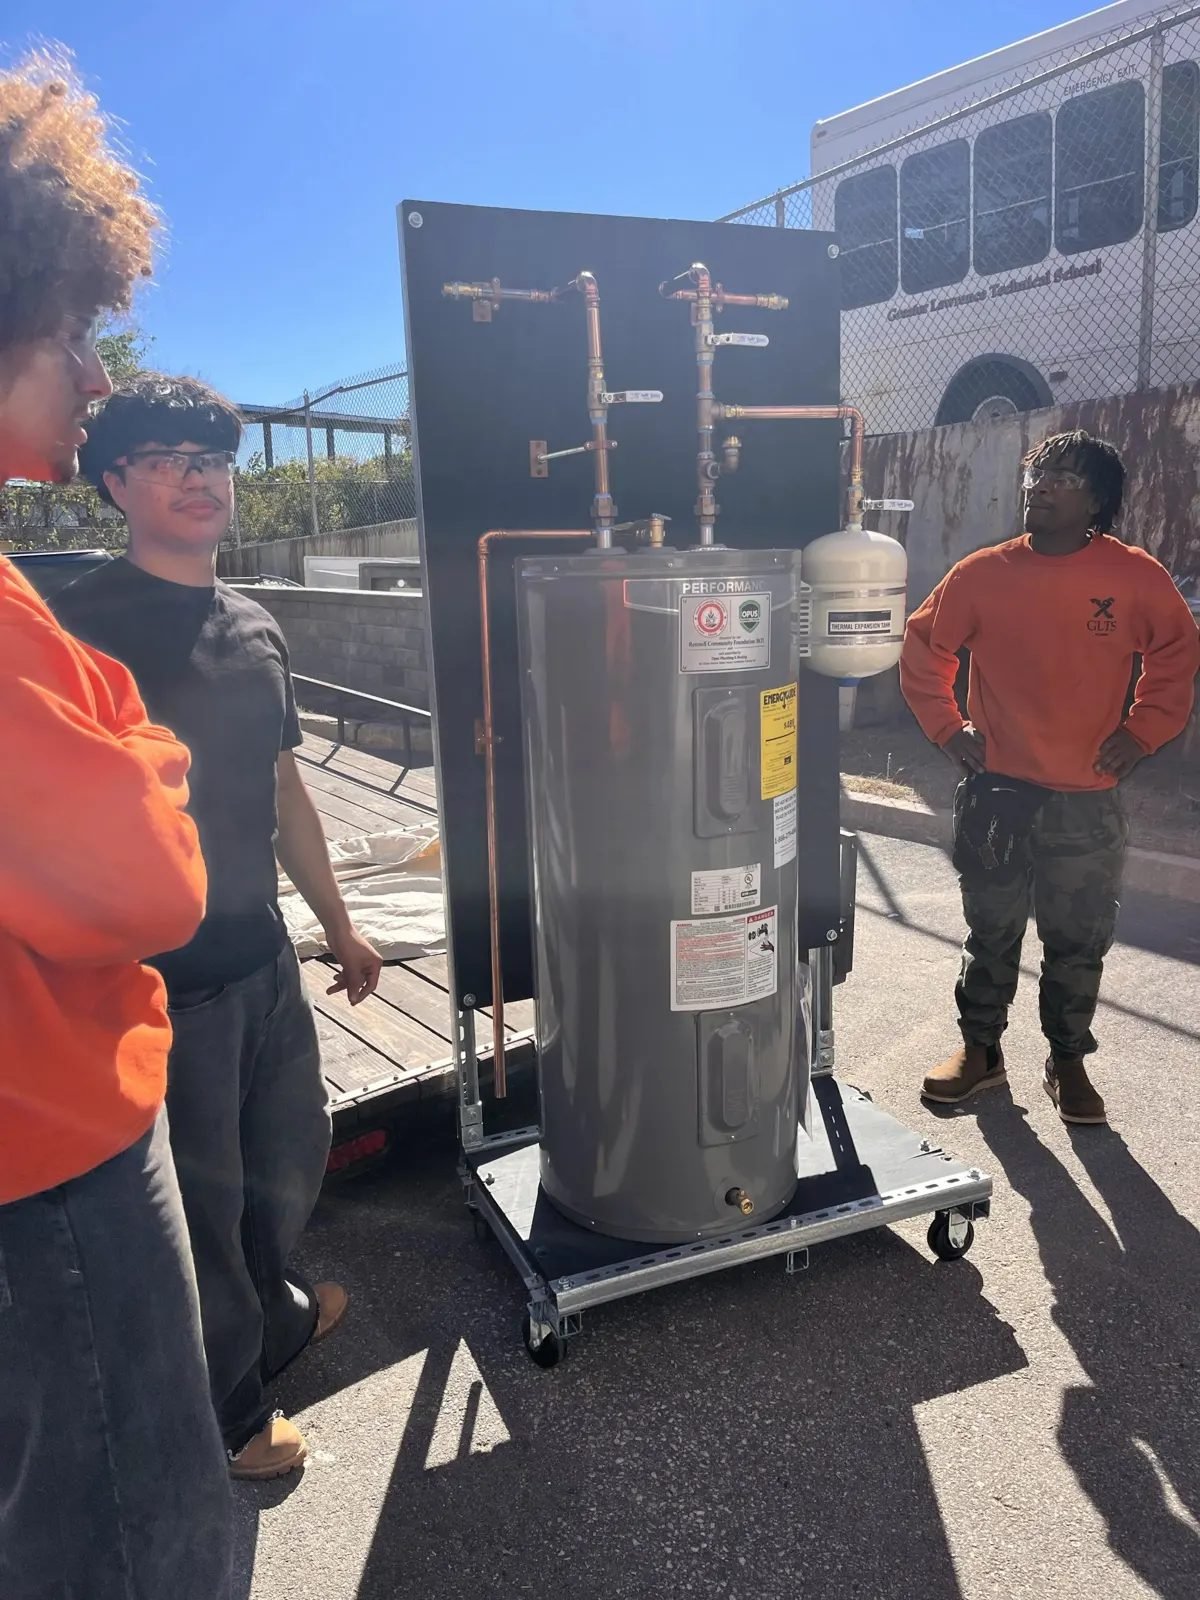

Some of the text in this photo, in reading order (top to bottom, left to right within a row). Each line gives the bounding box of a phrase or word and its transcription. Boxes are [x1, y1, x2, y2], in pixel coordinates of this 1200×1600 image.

[1063, 64, 1136, 96] EMERGENCY EXIT
[887, 258, 1102, 322] Greater Lawrence Technical School
[741, 609, 758, 619] OPUS
[854, 622, 880, 630] EXPANSION
[1086, 620, 1117, 632] GLTS
[754, 910, 774, 921] DANGER
